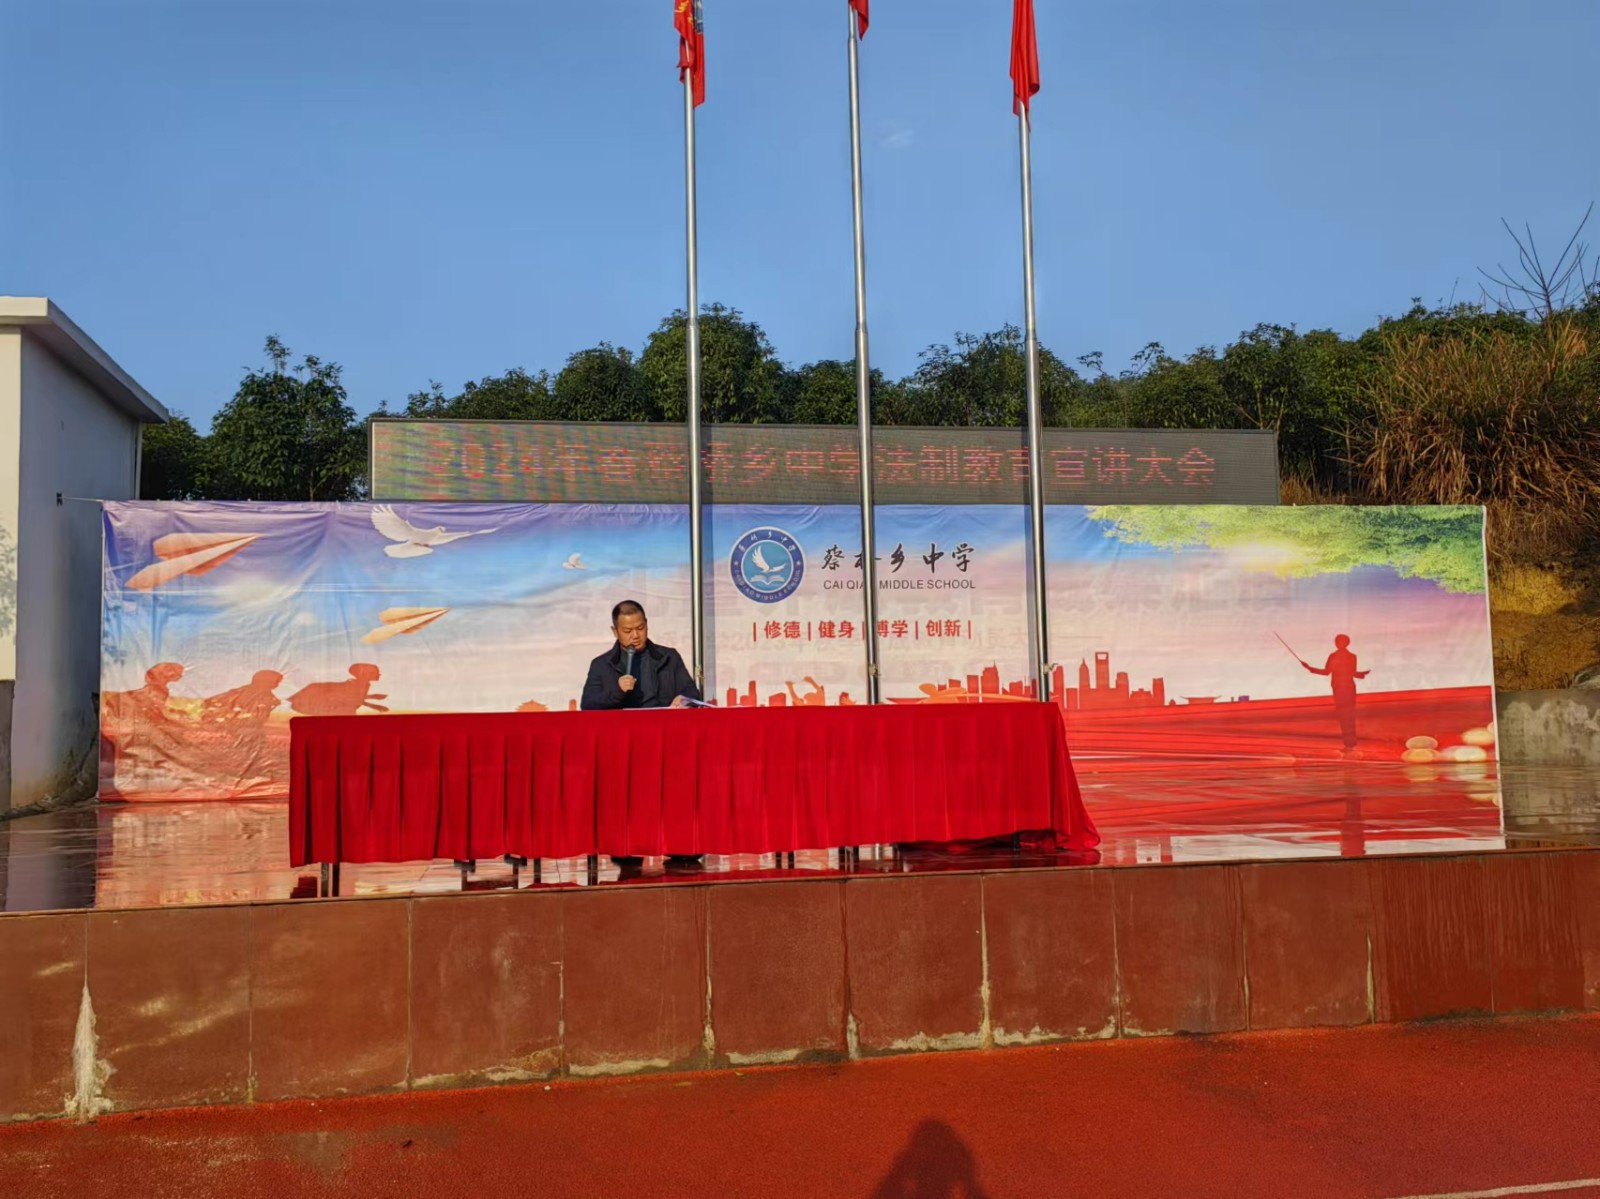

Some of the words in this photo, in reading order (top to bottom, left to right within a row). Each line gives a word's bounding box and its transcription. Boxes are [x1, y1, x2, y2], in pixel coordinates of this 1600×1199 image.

[823, 579, 844, 590] CAI
[846, 579, 868, 591] QIA
[879, 579, 924, 590] MIDDLE
[926, 579, 976, 589] SCHOOL
[764, 620, 801, 639] 修德
[818, 620, 855, 639] 健身
[876, 619, 909, 638] 博学
[925, 618, 962, 637] 创新
